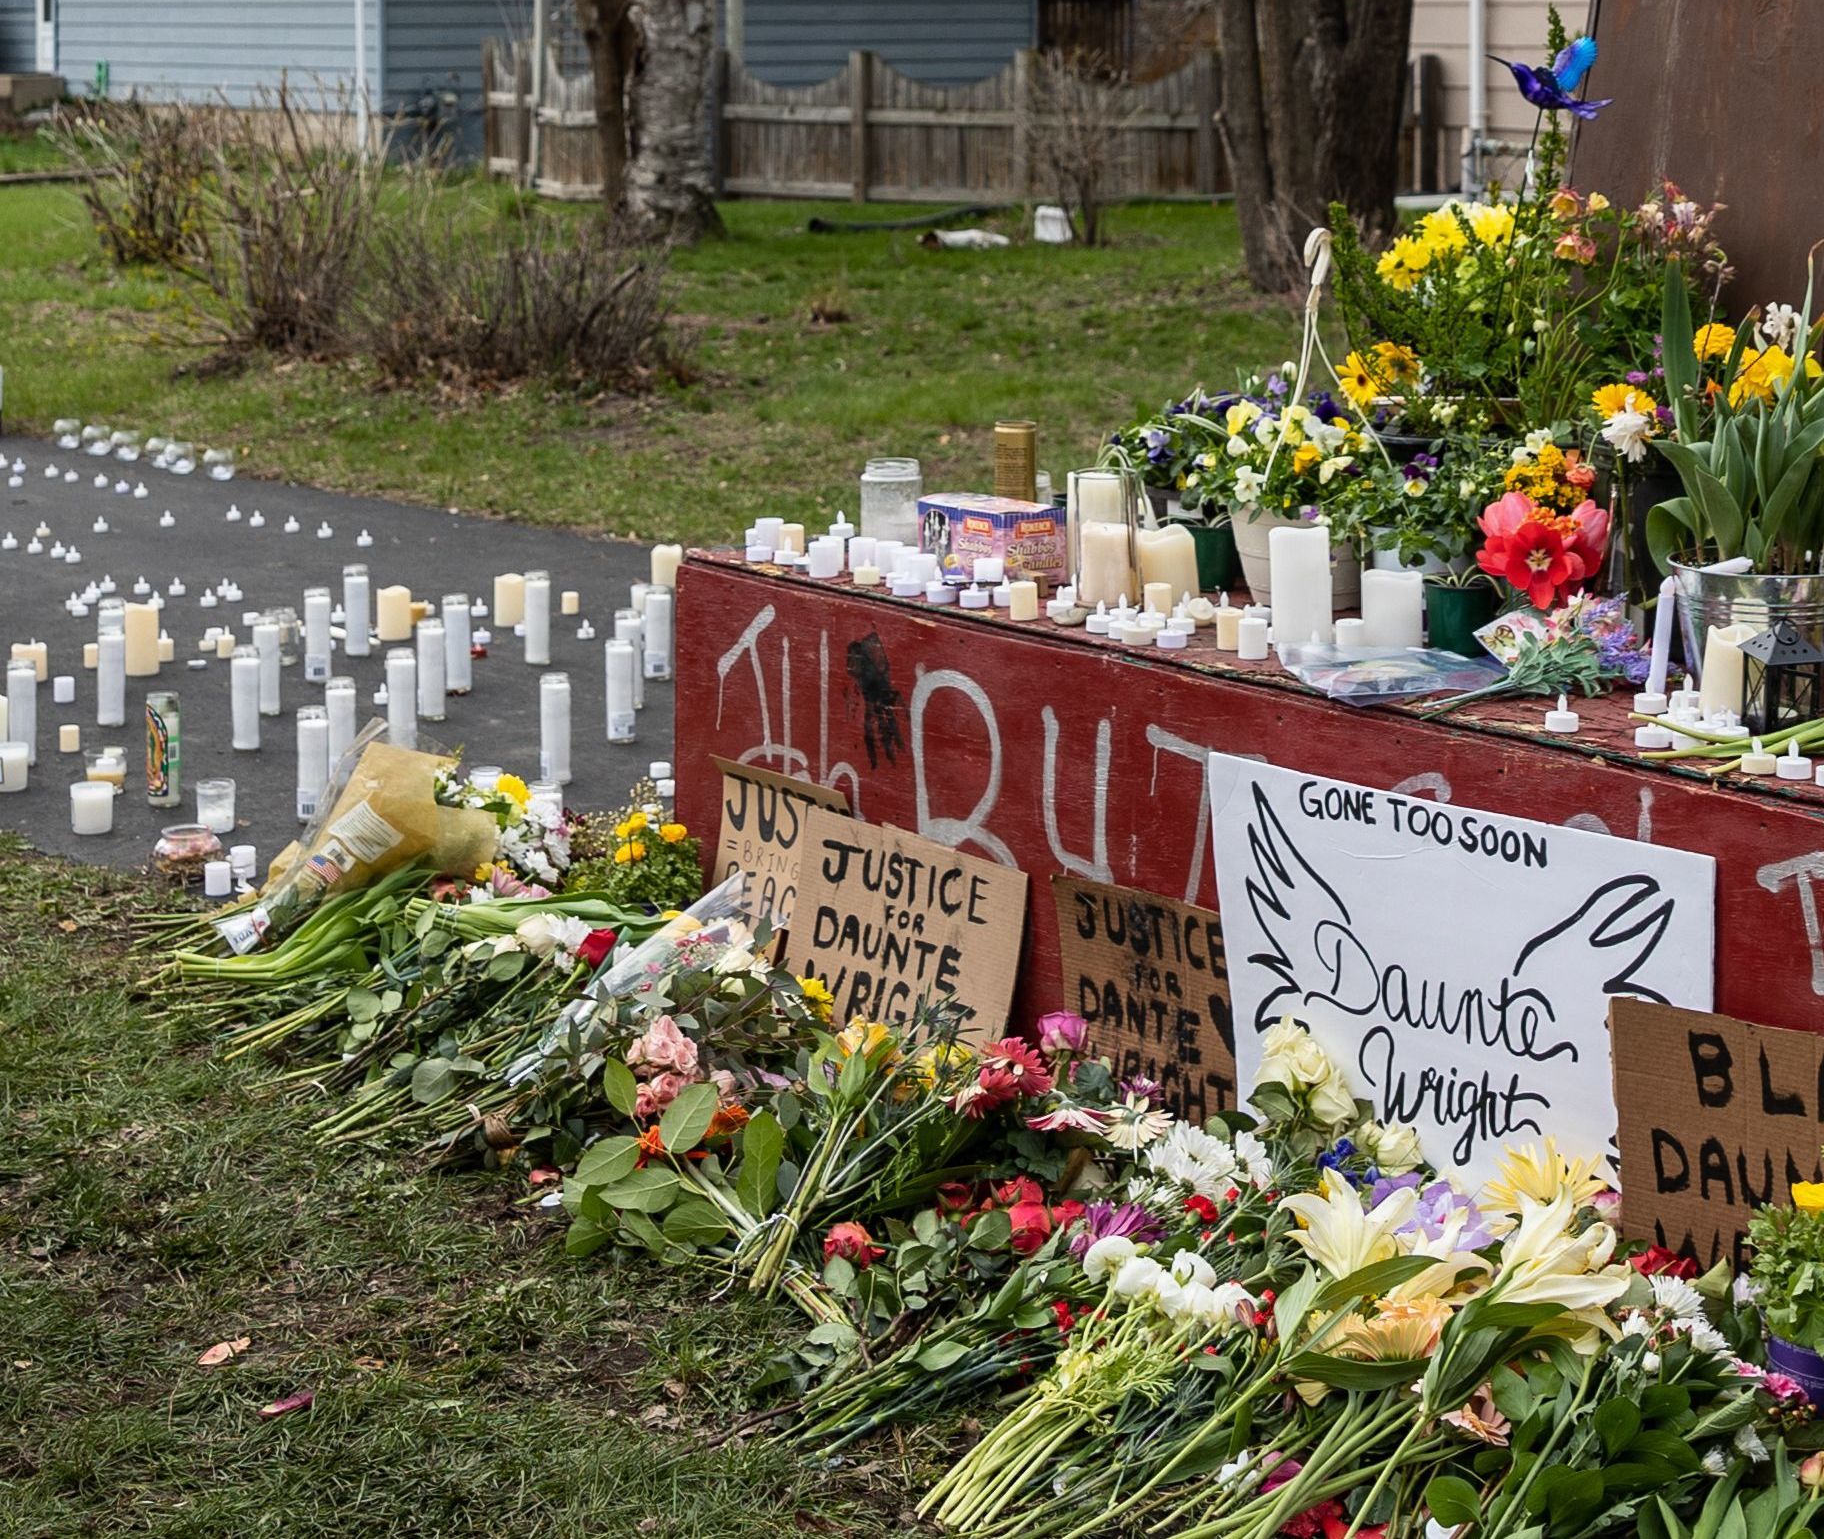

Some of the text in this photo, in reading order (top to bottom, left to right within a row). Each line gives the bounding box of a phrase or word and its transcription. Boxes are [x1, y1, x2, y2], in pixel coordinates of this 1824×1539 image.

[1298, 780, 1377, 825] GONE
[1386, 797, 1453, 846] TOO
[1458, 815, 1548, 870] SOON
[726, 860, 798, 919] PEAC
[822, 839, 992, 925] JUSTICE
[885, 904, 926, 936] FOR
[812, 906, 963, 994] DAUNTE
[1073, 892, 1227, 979] JUSTICE
[1079, 974, 1201, 1065] DANTE
[1133, 962, 1183, 999] FOR
[1303, 919, 1578, 1063] Daunte
[1358, 1025, 1550, 1167] Wright
